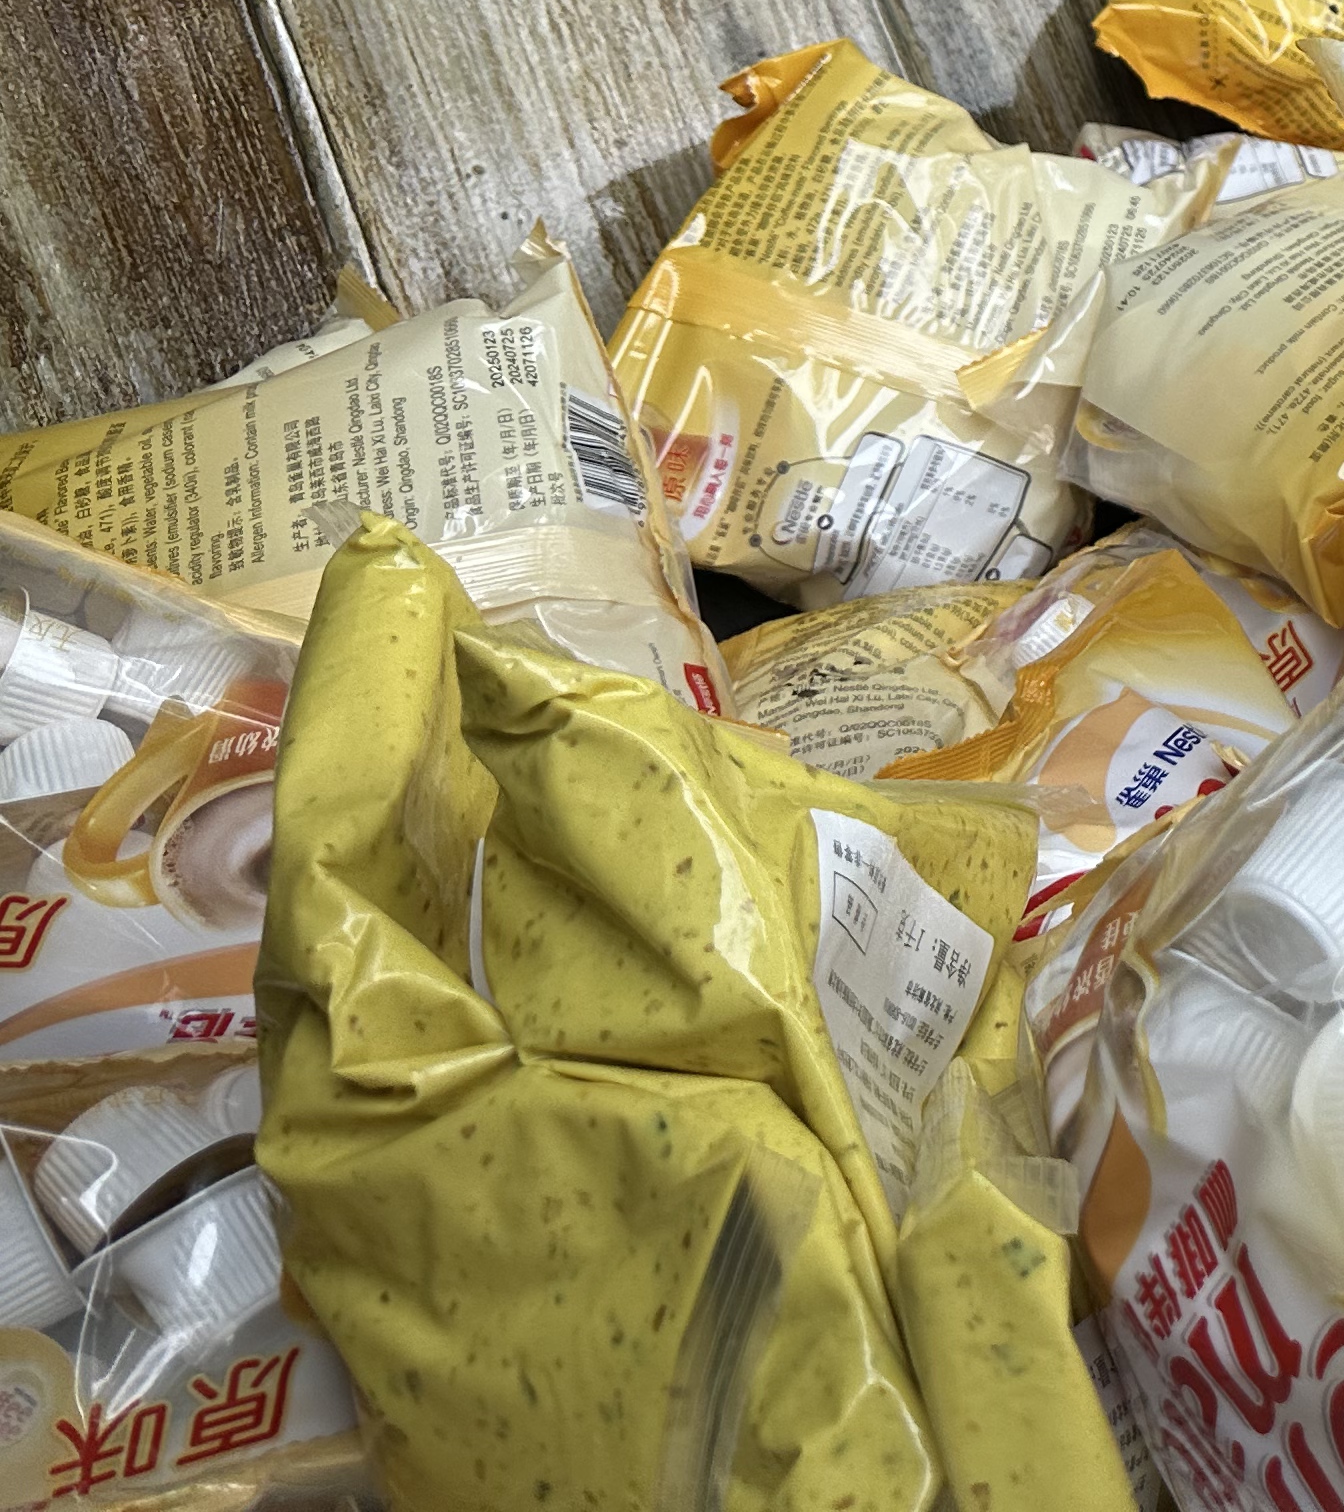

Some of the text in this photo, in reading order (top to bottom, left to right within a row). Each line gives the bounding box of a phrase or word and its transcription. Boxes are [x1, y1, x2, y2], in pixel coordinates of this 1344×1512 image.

[482, 330, 505, 388] 20250123
[500, 327, 523, 384] 20240725
[348, 393, 365, 434] Qingdao
[368, 392, 384, 417] Laixi
[371, 416, 385, 434] Lu,
[391, 397, 408, 447] Shandong
[519, 326, 567, 505] 批次号 42071126
[181, 425, 196, 465] colorant
[245, 419, 259, 460] Contain
[284, 419, 306, 504] 青岛雀巢有限公司
[372, 433, 386, 446] Xi
[374, 445, 388, 466] Hai
[140, 452, 158, 502] vegetable
[161, 448, 179, 490] (sodium
[247, 460, 263, 516] Information:
[376, 465, 390, 488] Wei
[398, 447, 416, 494] Qingdao,
[663, 444, 689, 502] 原味
[54, 475, 69, 515] Flavored
[143, 504, 157, 538] Water,
[164, 492, 182, 545] (emulsifier
[187, 506, 204, 550] regulator
[251, 516, 268, 563] Allergen
[188, 552, 204, 585] acidity
[1115, 762, 1169, 808] 雀巢
[48, 1347, 300, 1497] 原味
